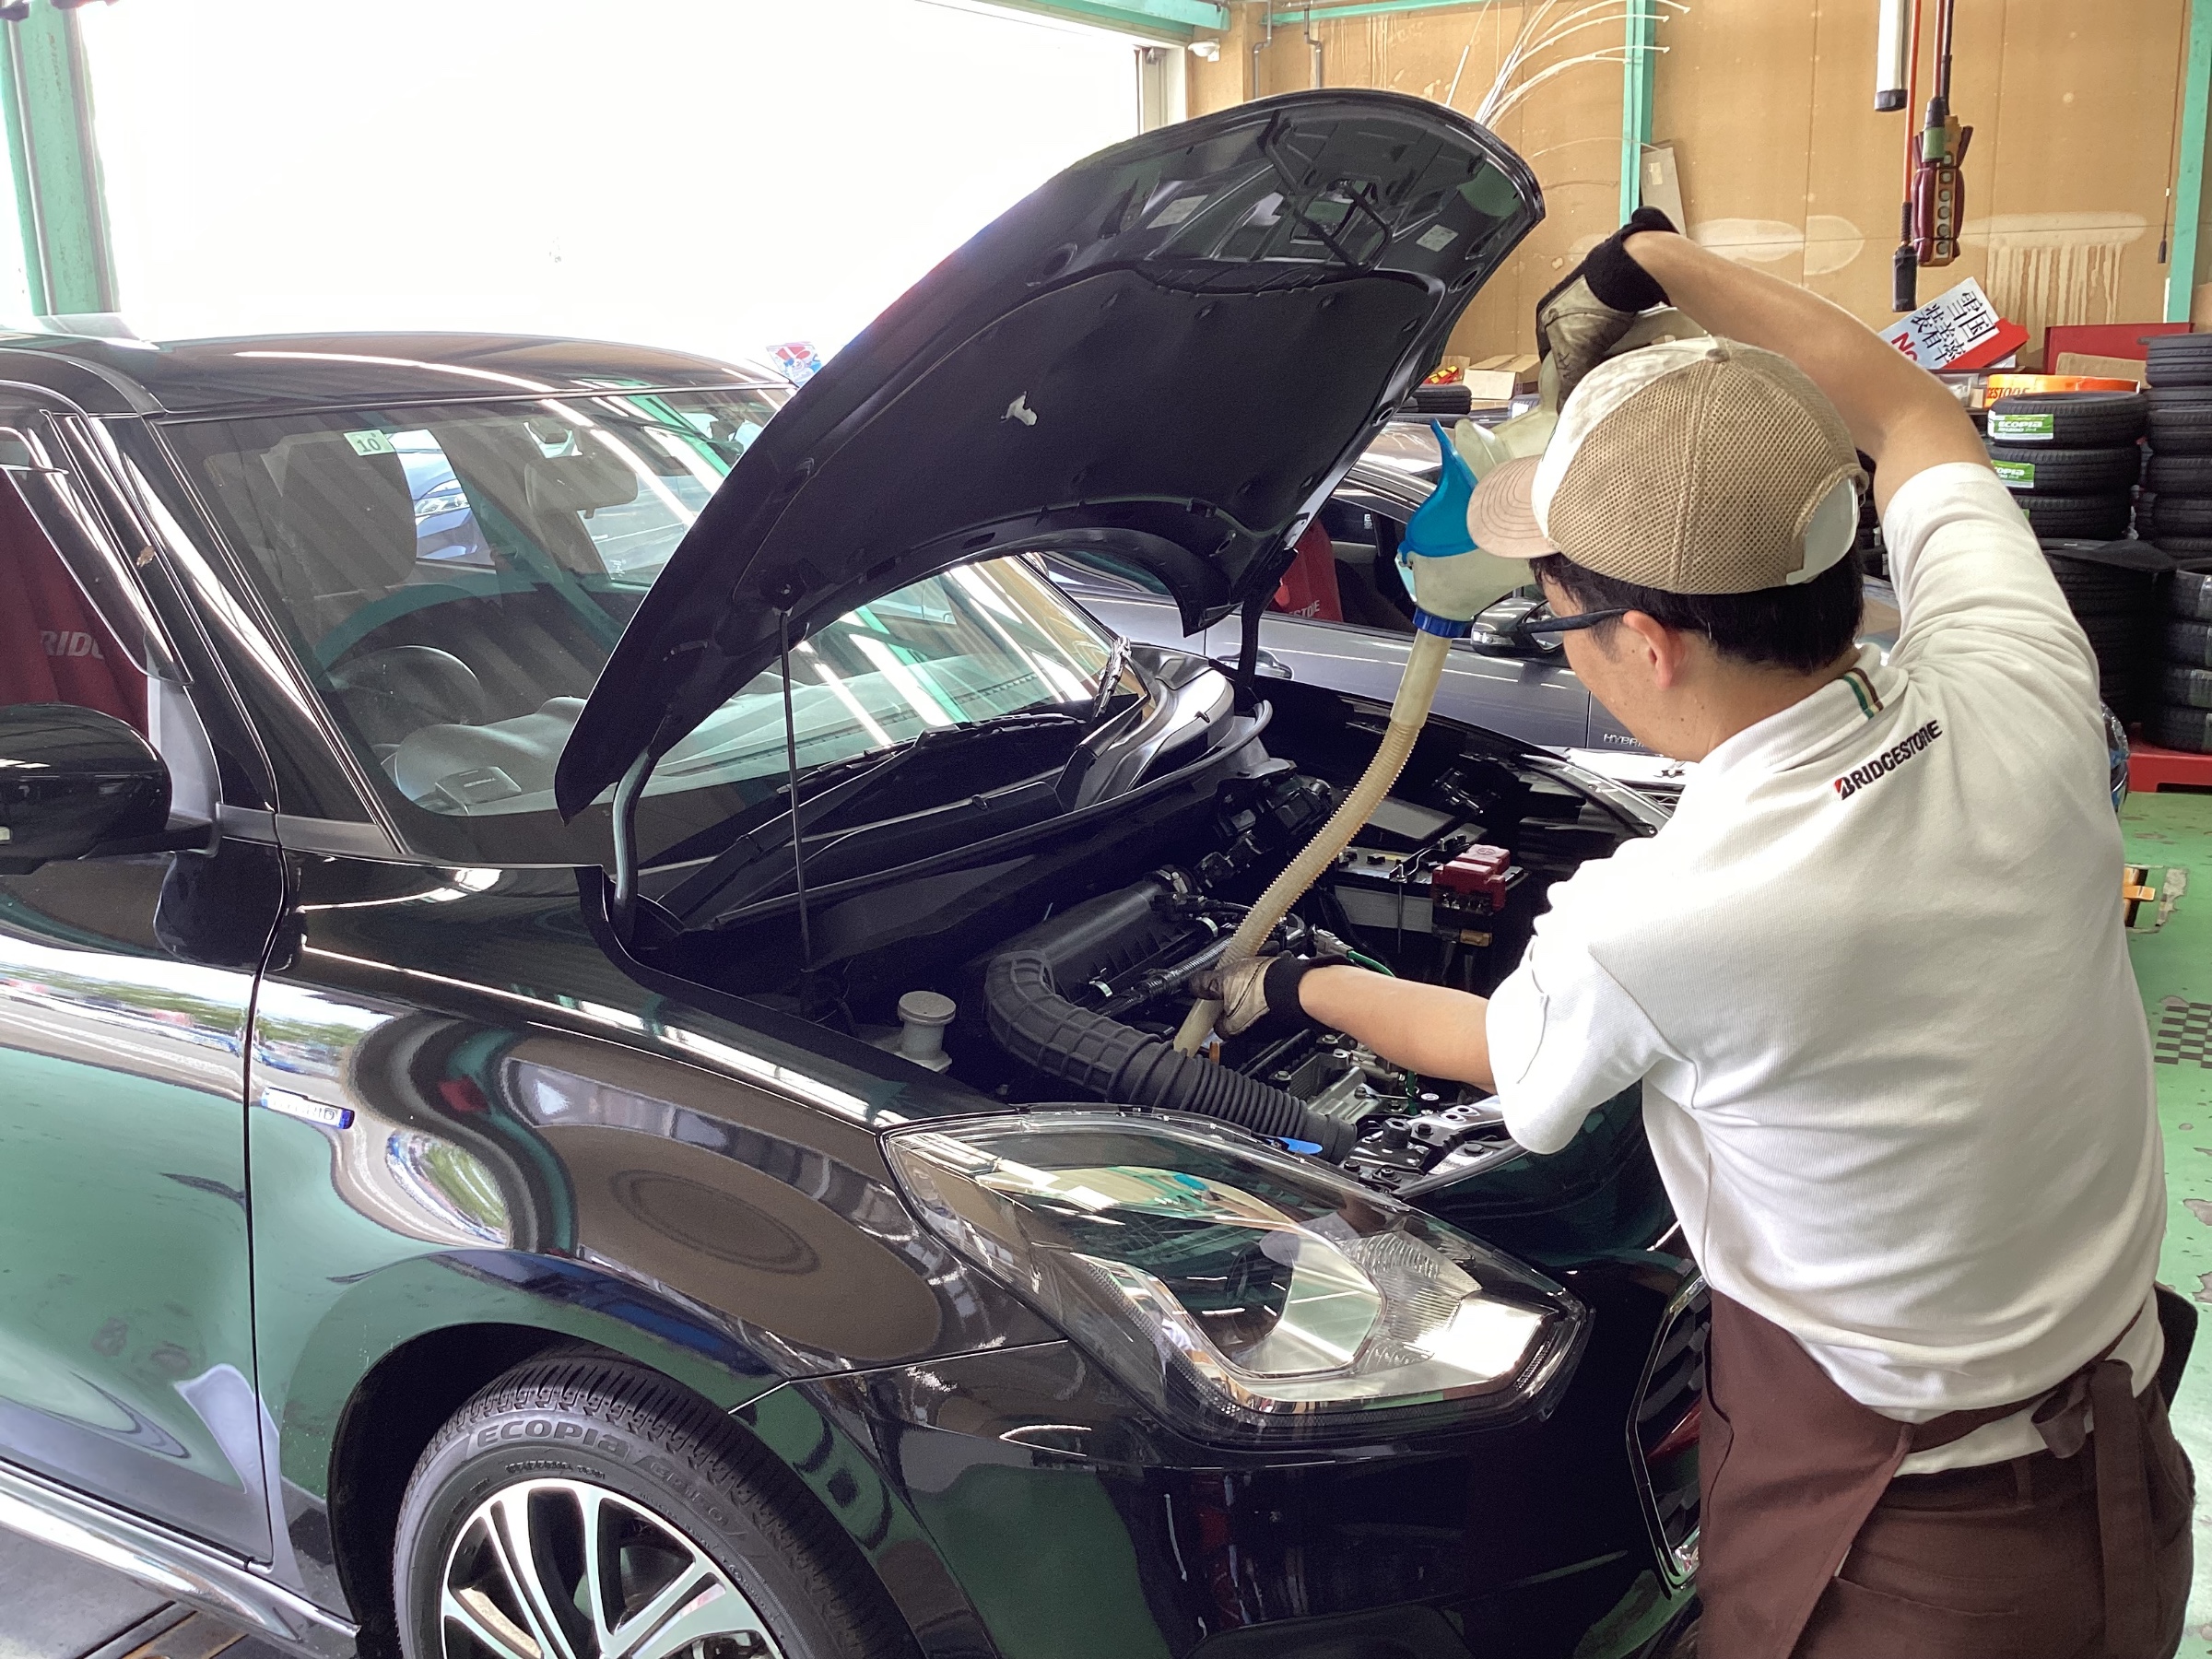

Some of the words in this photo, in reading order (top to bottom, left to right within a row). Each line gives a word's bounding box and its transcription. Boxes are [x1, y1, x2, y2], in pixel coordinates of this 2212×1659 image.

[1911, 303, 1966, 364] 装着率
[1947, 290, 1996, 343] 雪国
[357, 438, 382, 453] 10
[1833, 719, 1943, 800] BRIDGESTONE
